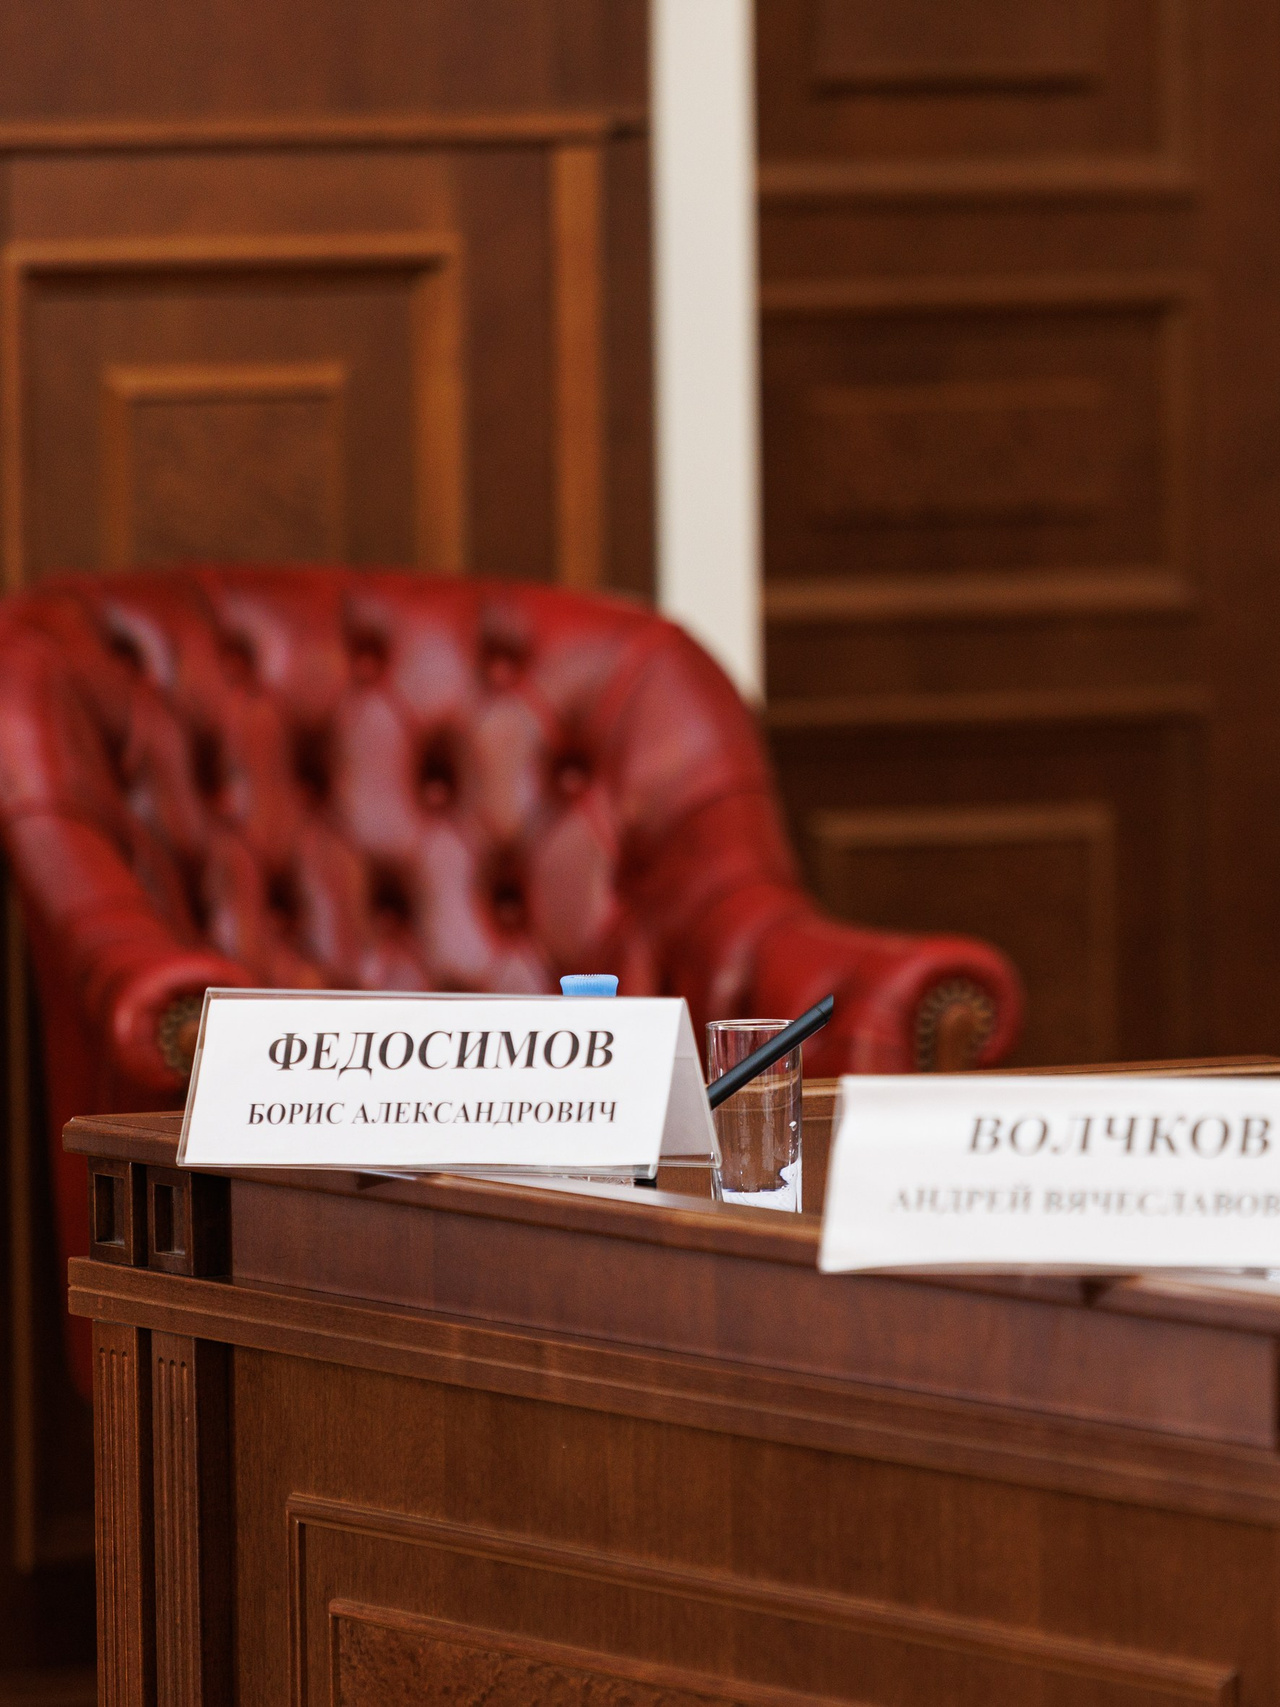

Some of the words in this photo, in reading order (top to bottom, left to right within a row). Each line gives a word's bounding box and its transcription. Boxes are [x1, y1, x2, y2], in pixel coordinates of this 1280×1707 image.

[267, 1028, 615, 1079] ФЕДОСИМОВ
[247, 1101, 345, 1126] БОРИС
[351, 1100, 618, 1127] АЛЕКСАНДРОВИЧ
[967, 1113, 1274, 1158] ВОЛЧКОВ
[890, 1182, 1034, 1217] АНДРЕЙ
